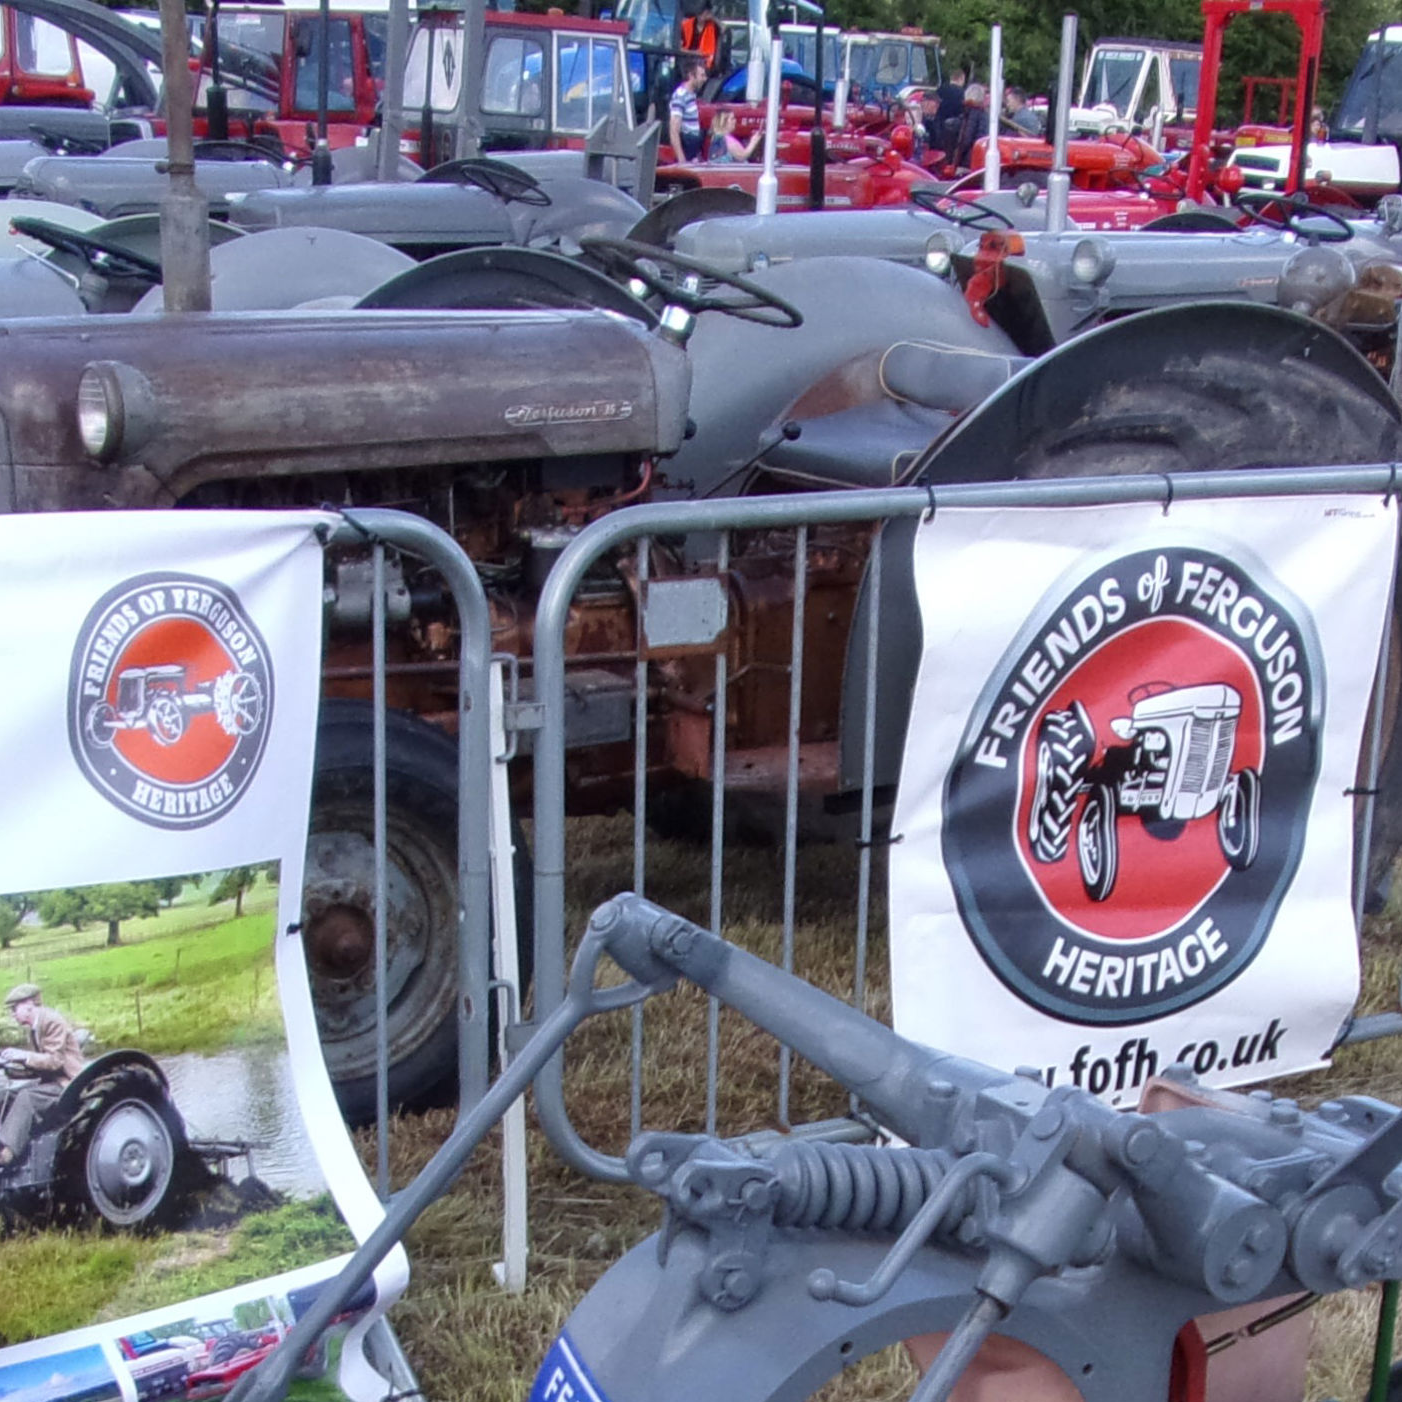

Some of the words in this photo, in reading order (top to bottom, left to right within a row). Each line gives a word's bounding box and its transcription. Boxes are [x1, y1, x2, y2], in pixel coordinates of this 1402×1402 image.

[84, 603, 140, 697] FRIENDS
[138, 589, 166, 616] OF
[171, 588, 258, 665] FERGUSON
[974, 576, 1127, 769] FRIENDS
[1137, 555, 1170, 613] of
[1175, 560, 1302, 746] FERGUSON
[131, 772, 234, 815] HERITAGE
[1042, 916, 1229, 999] HERITAGE
